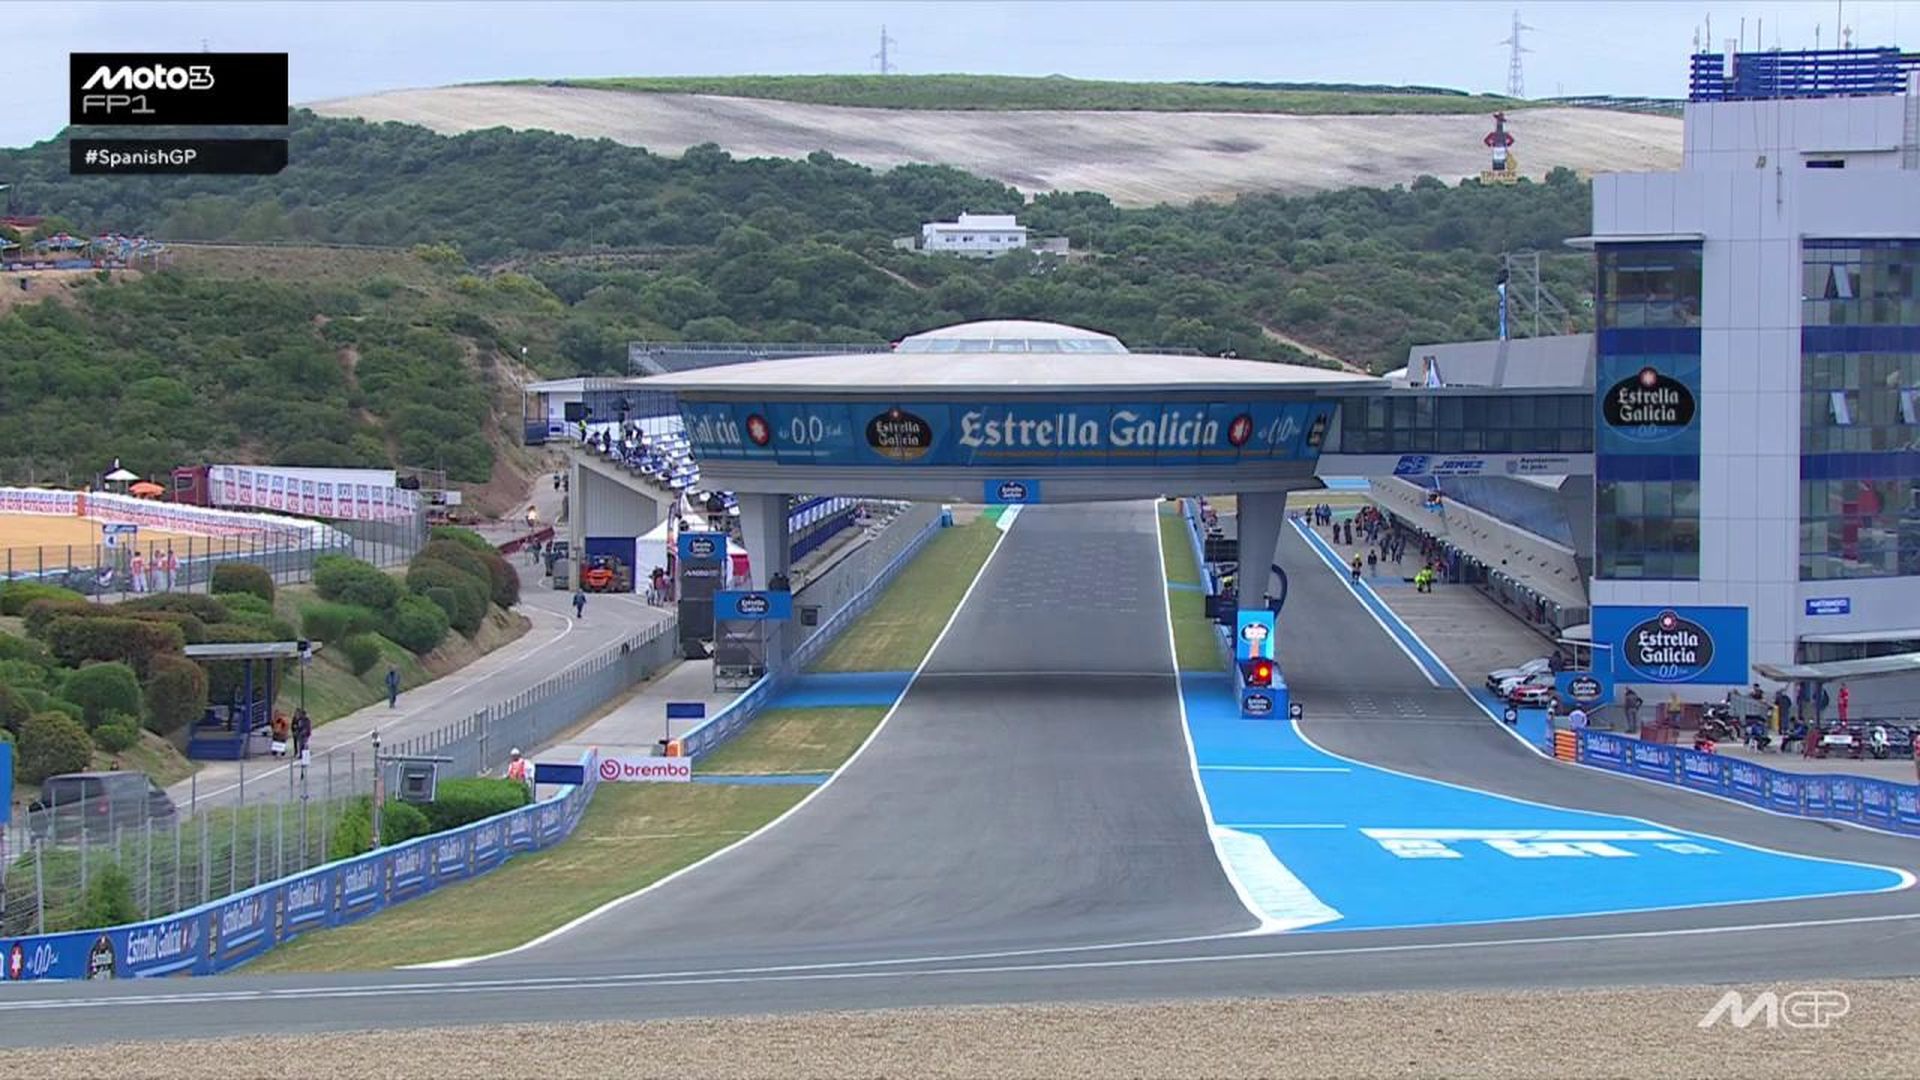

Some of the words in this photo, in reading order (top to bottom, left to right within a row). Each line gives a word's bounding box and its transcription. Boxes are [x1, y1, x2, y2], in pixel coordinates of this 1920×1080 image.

[1618, 387, 1679, 404] Estrella
[1620, 404, 1676, 422] Galicia
[959, 411, 1099, 447] Estrella
[1109, 411, 1219, 447] Galicia
[1638, 630, 1698, 646] Estrella
[1641, 646, 1696, 663] Galicia
[624, 762, 689, 777] brembo
